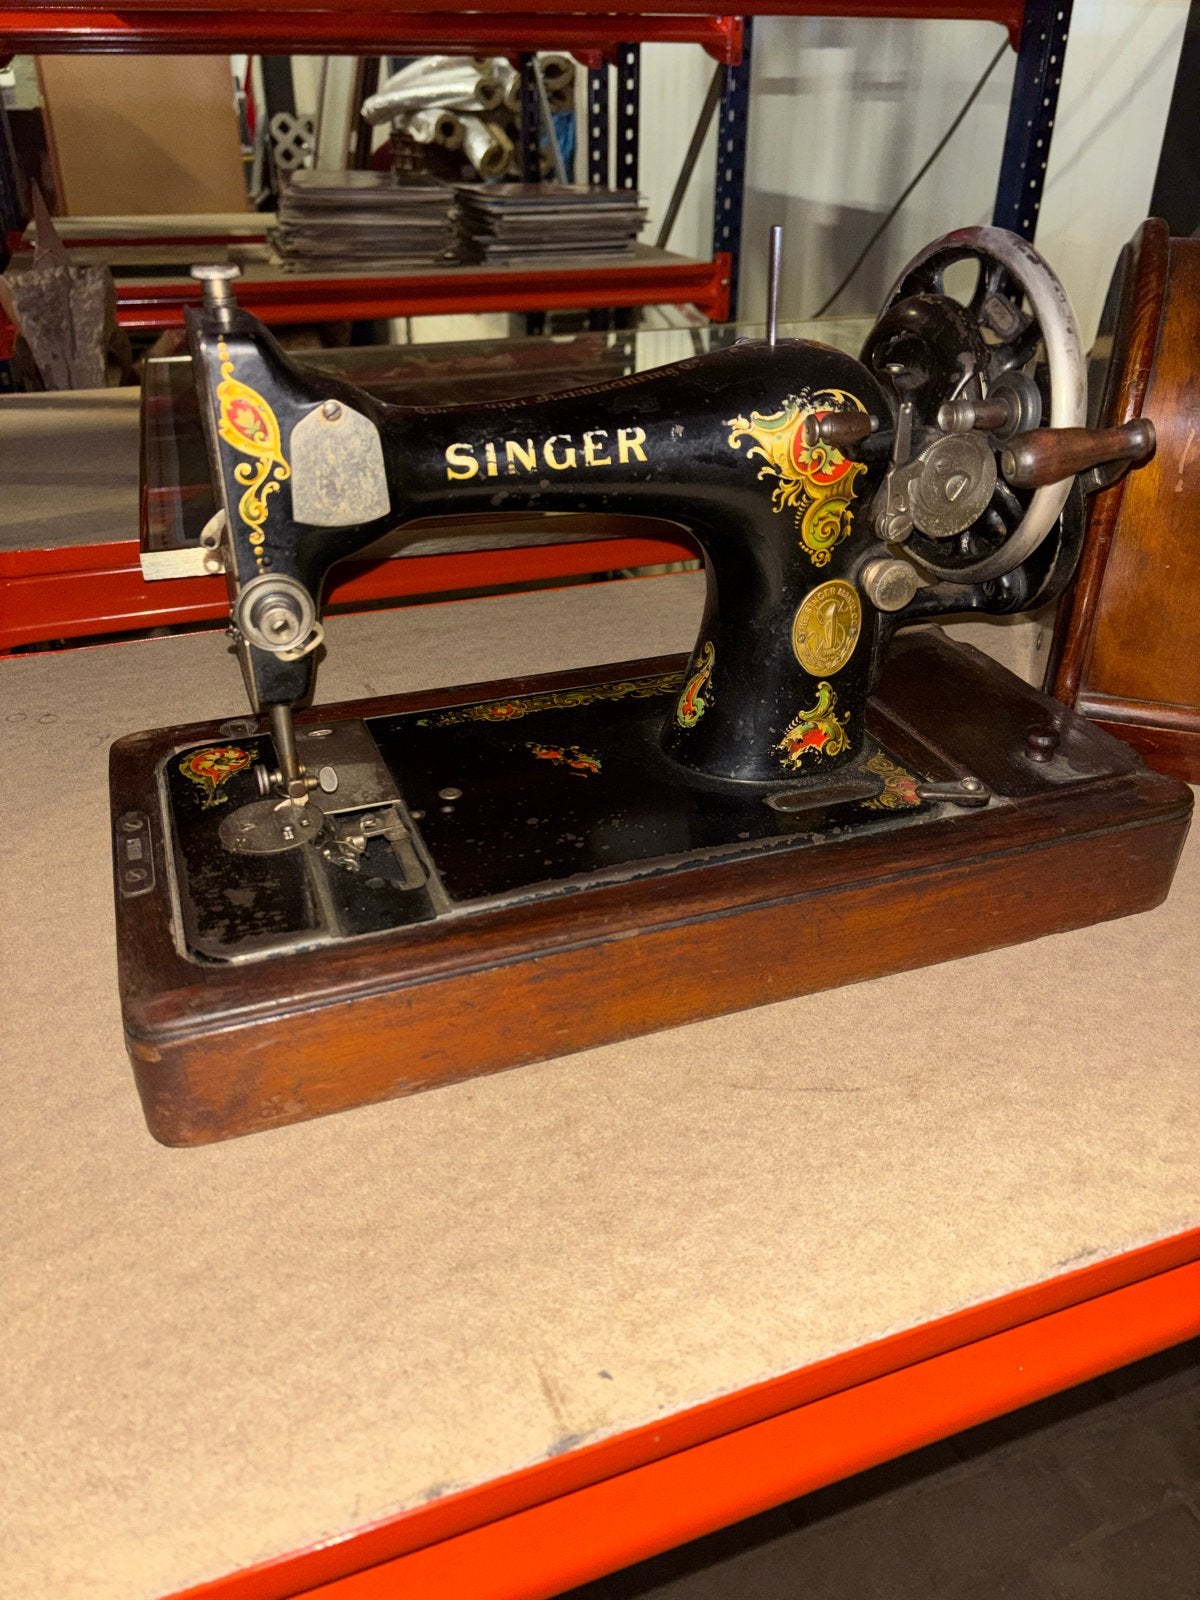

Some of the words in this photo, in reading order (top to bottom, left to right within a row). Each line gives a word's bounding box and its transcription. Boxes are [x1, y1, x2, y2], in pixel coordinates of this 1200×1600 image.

[444, 426, 648, 481] SINGER
[799, 616, 809, 635] THE
[805, 587, 836, 614] SINGER
